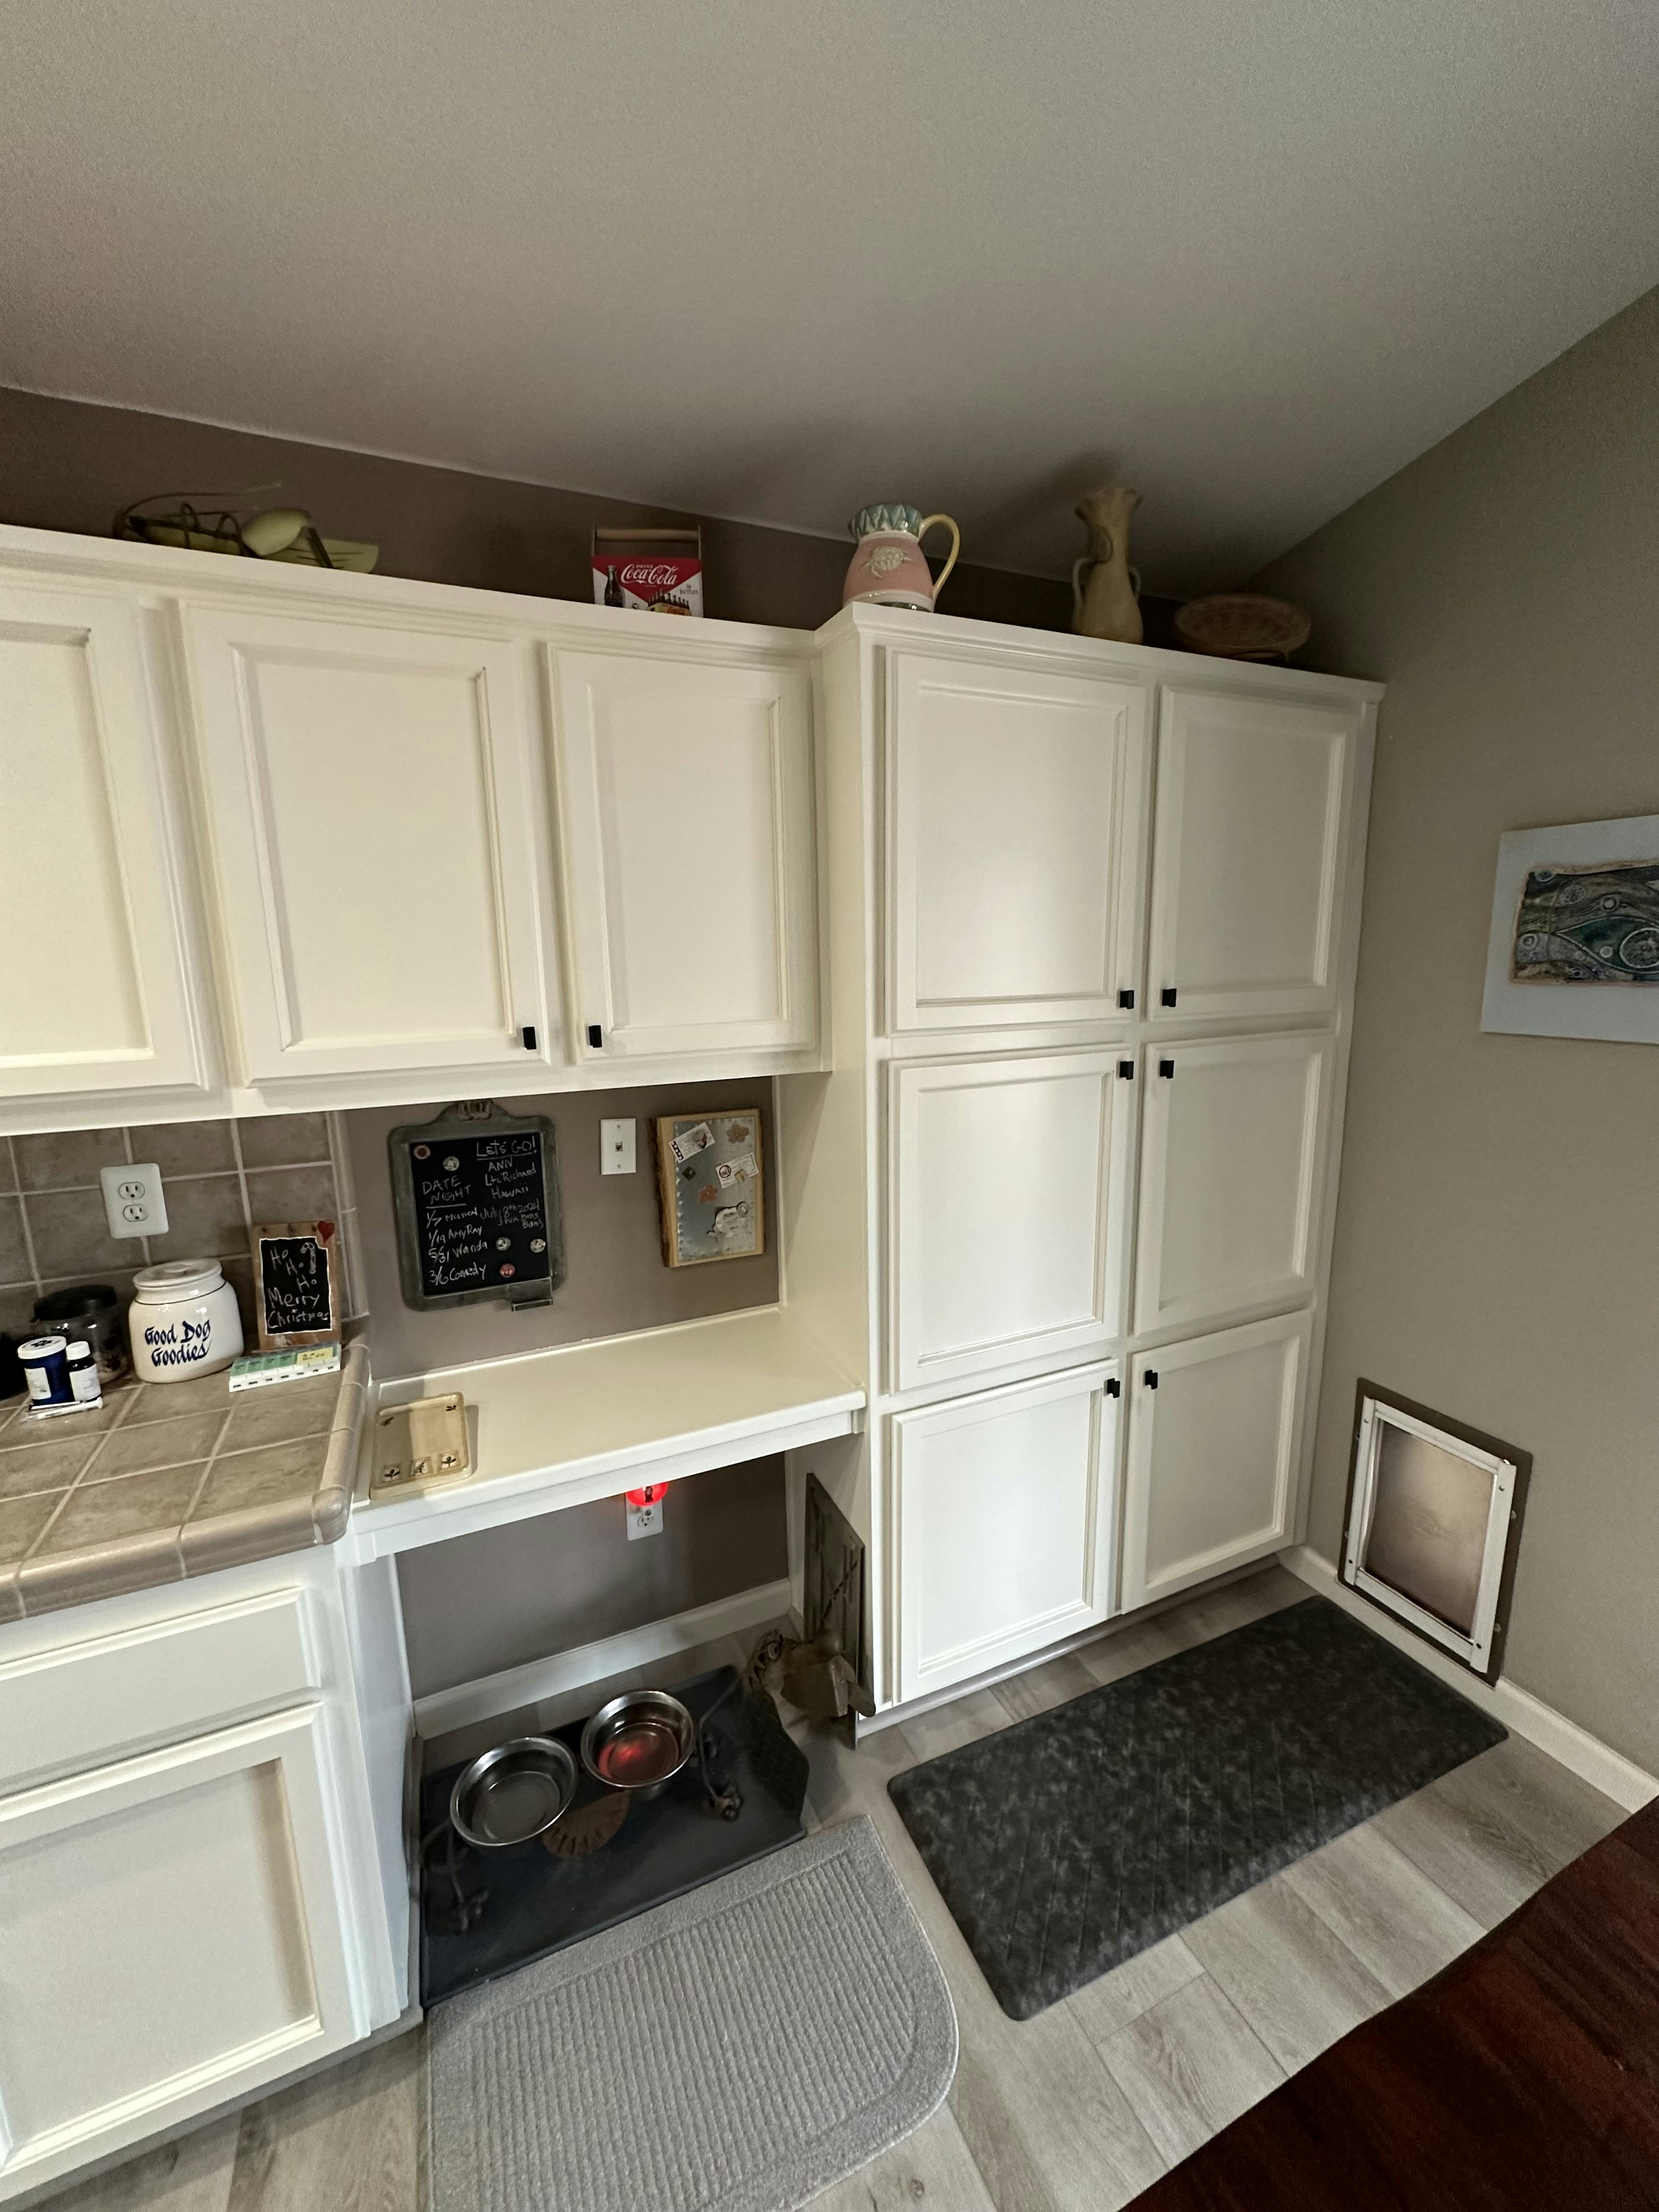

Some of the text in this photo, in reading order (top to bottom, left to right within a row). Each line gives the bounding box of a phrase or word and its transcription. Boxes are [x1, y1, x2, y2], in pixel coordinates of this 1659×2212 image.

[621, 564, 679, 585] Coca-Cola
[512, 1135, 537, 1154] GO!
[422, 1175, 461, 1195] DATE
[430, 1185, 470, 1204] NIGHT
[426, 1210, 442, 1228] 1/7
[429, 1229, 446, 1247] 1/19
[270, 1246, 289, 1270] Ho
[428, 1239, 488, 1263] 5/31 Wanda
[286, 1258, 304, 1275] Ho
[429, 1262, 486, 1286] 3/6 Comedy
[296, 1274, 317, 1293] Ho
[267, 1287, 320, 1309] Merry
[267, 1309, 329, 1328] Christmas
[145, 1319, 210, 1345] Good Dog
[151, 1339, 212, 1367] Goodies
